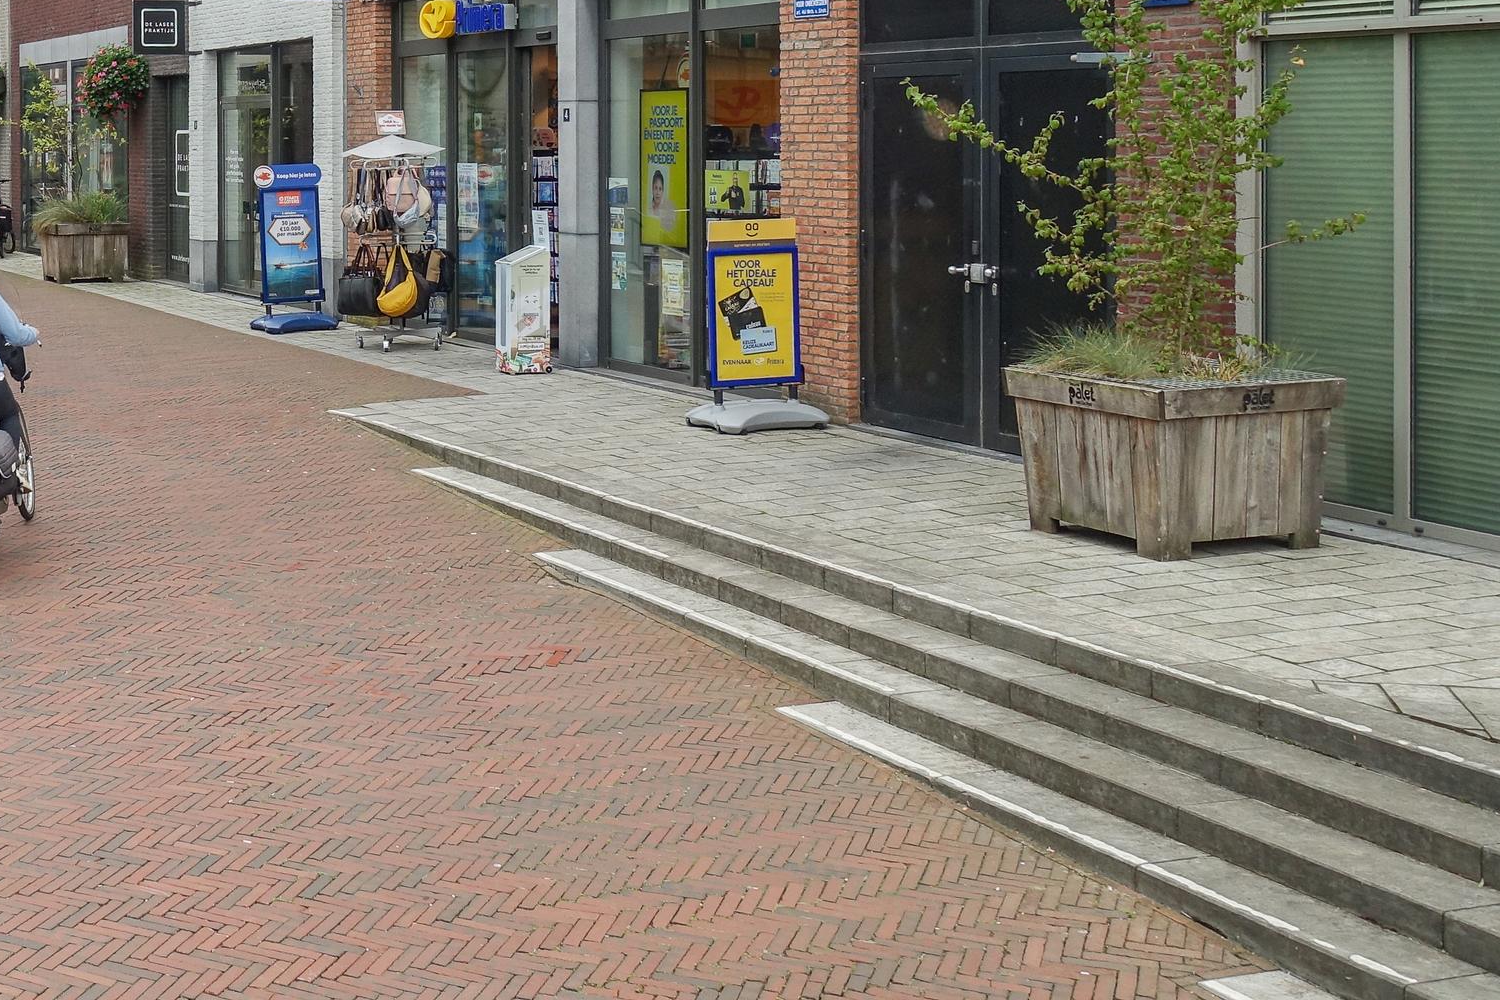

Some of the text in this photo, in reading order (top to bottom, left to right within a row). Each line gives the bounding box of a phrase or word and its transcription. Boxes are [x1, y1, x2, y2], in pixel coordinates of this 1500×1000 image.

[564, 109, 569, 120] 4
[651, 105, 678, 116] VOOR JE
[649, 117, 684, 128] PASPOORT.
[654, 142, 673, 152] VOOR
[648, 153, 677, 165] MOEDER.
[733, 260, 761, 268] VOOR
[726, 269, 777, 278] HET IDEALE
[733, 279, 774, 287] CADEAU!
[1069, 383, 1096, 404] palet
